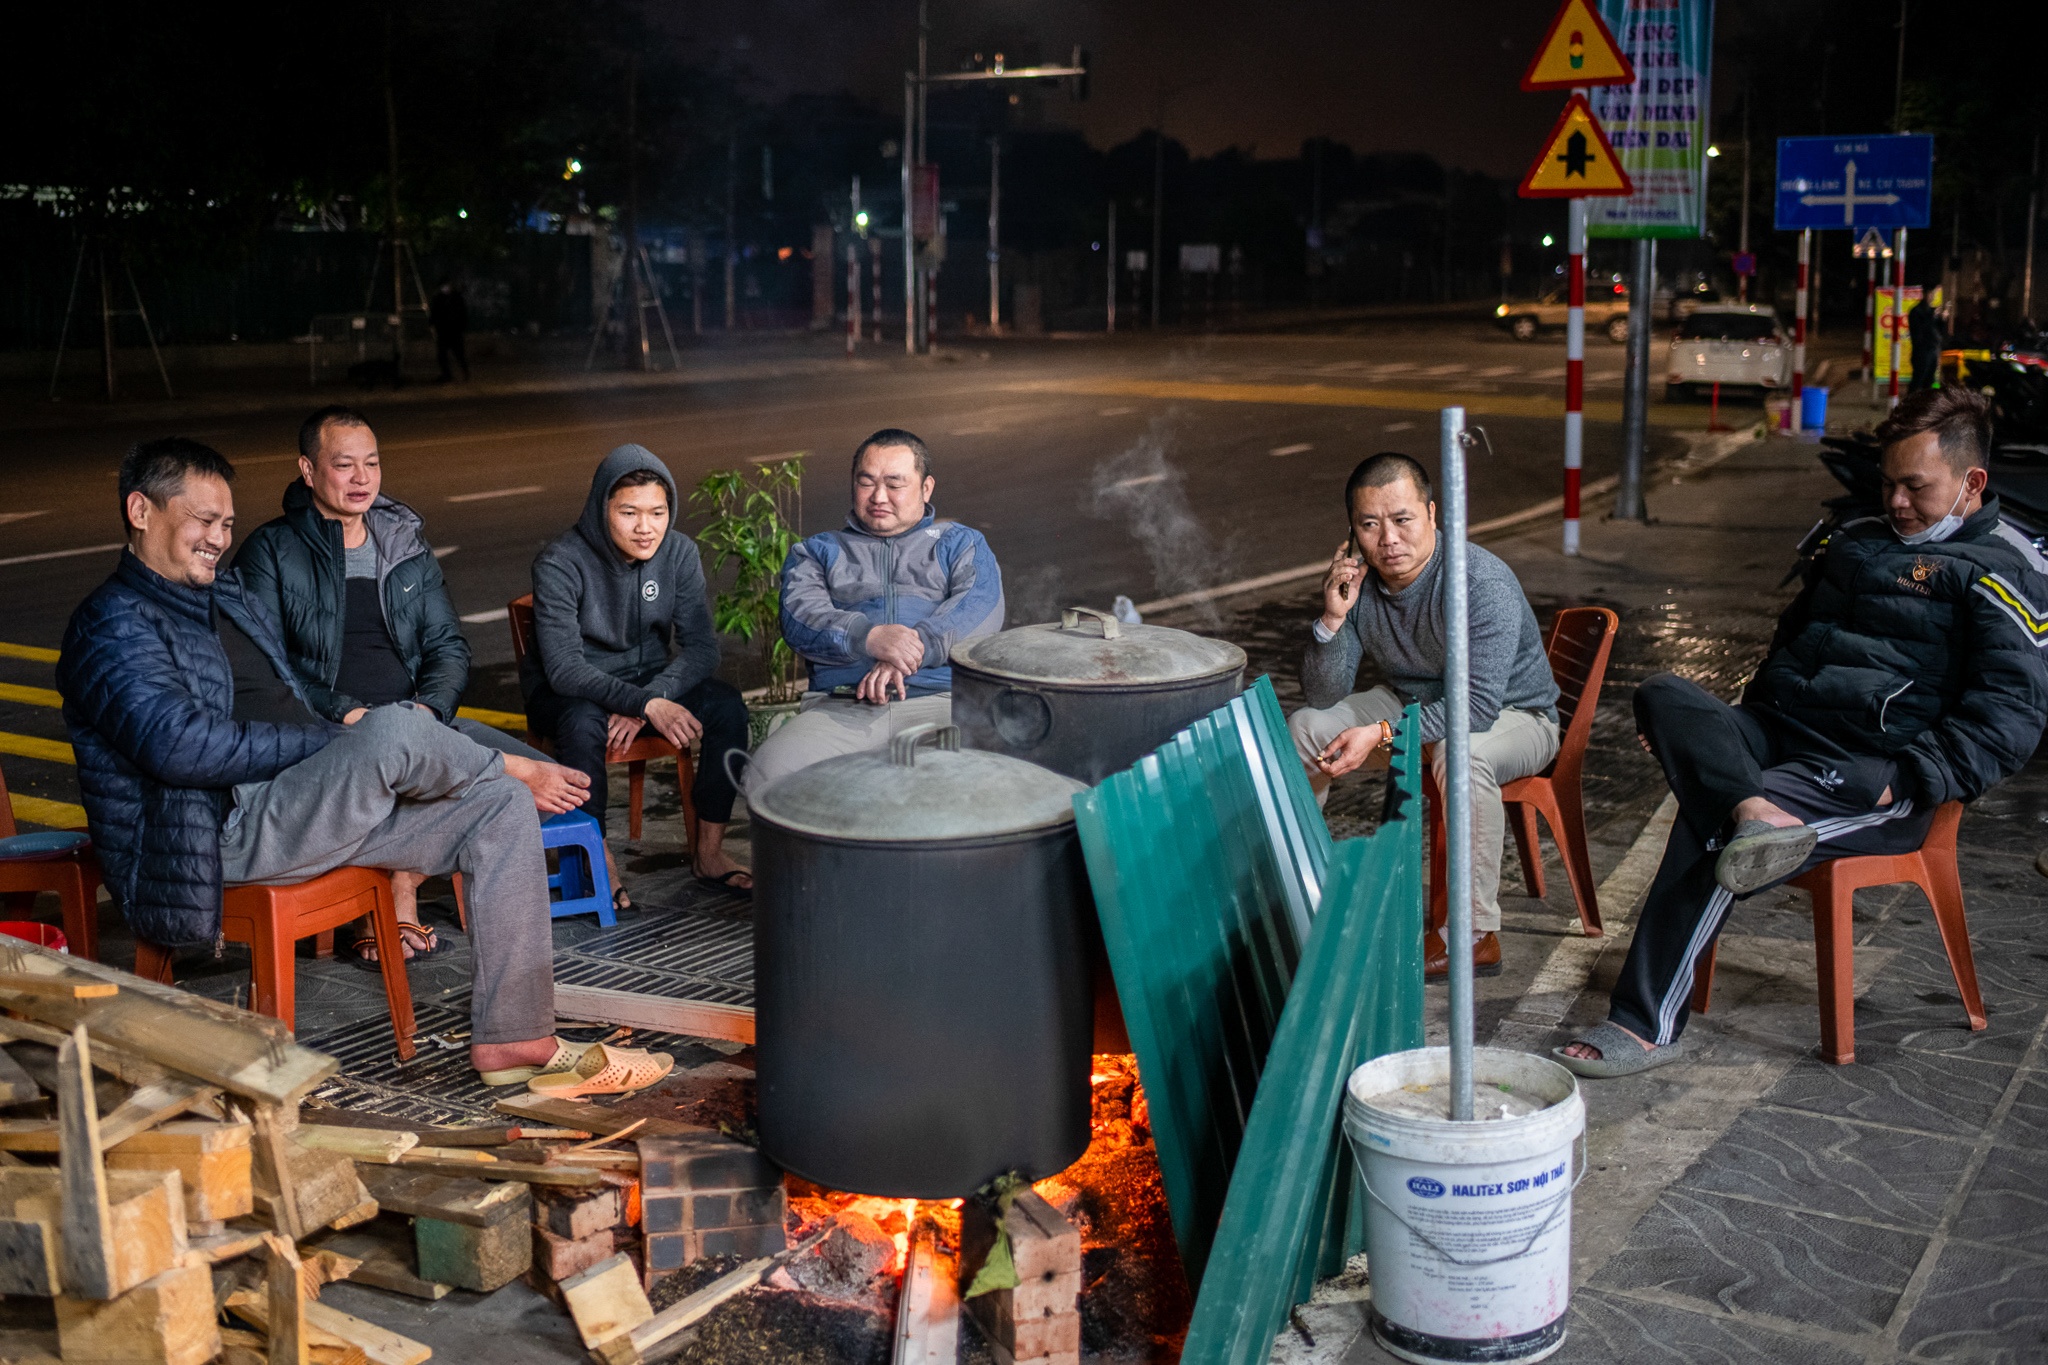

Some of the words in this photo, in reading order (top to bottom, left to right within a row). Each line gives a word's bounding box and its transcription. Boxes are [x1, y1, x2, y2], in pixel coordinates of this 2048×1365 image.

[1896, 576, 1932, 596] HUNTER
[1452, 1183, 1503, 1197] HALITEX
[1507, 1178, 1530, 1194] SƠN
[1533, 1171, 1548, 1188] NỘI
